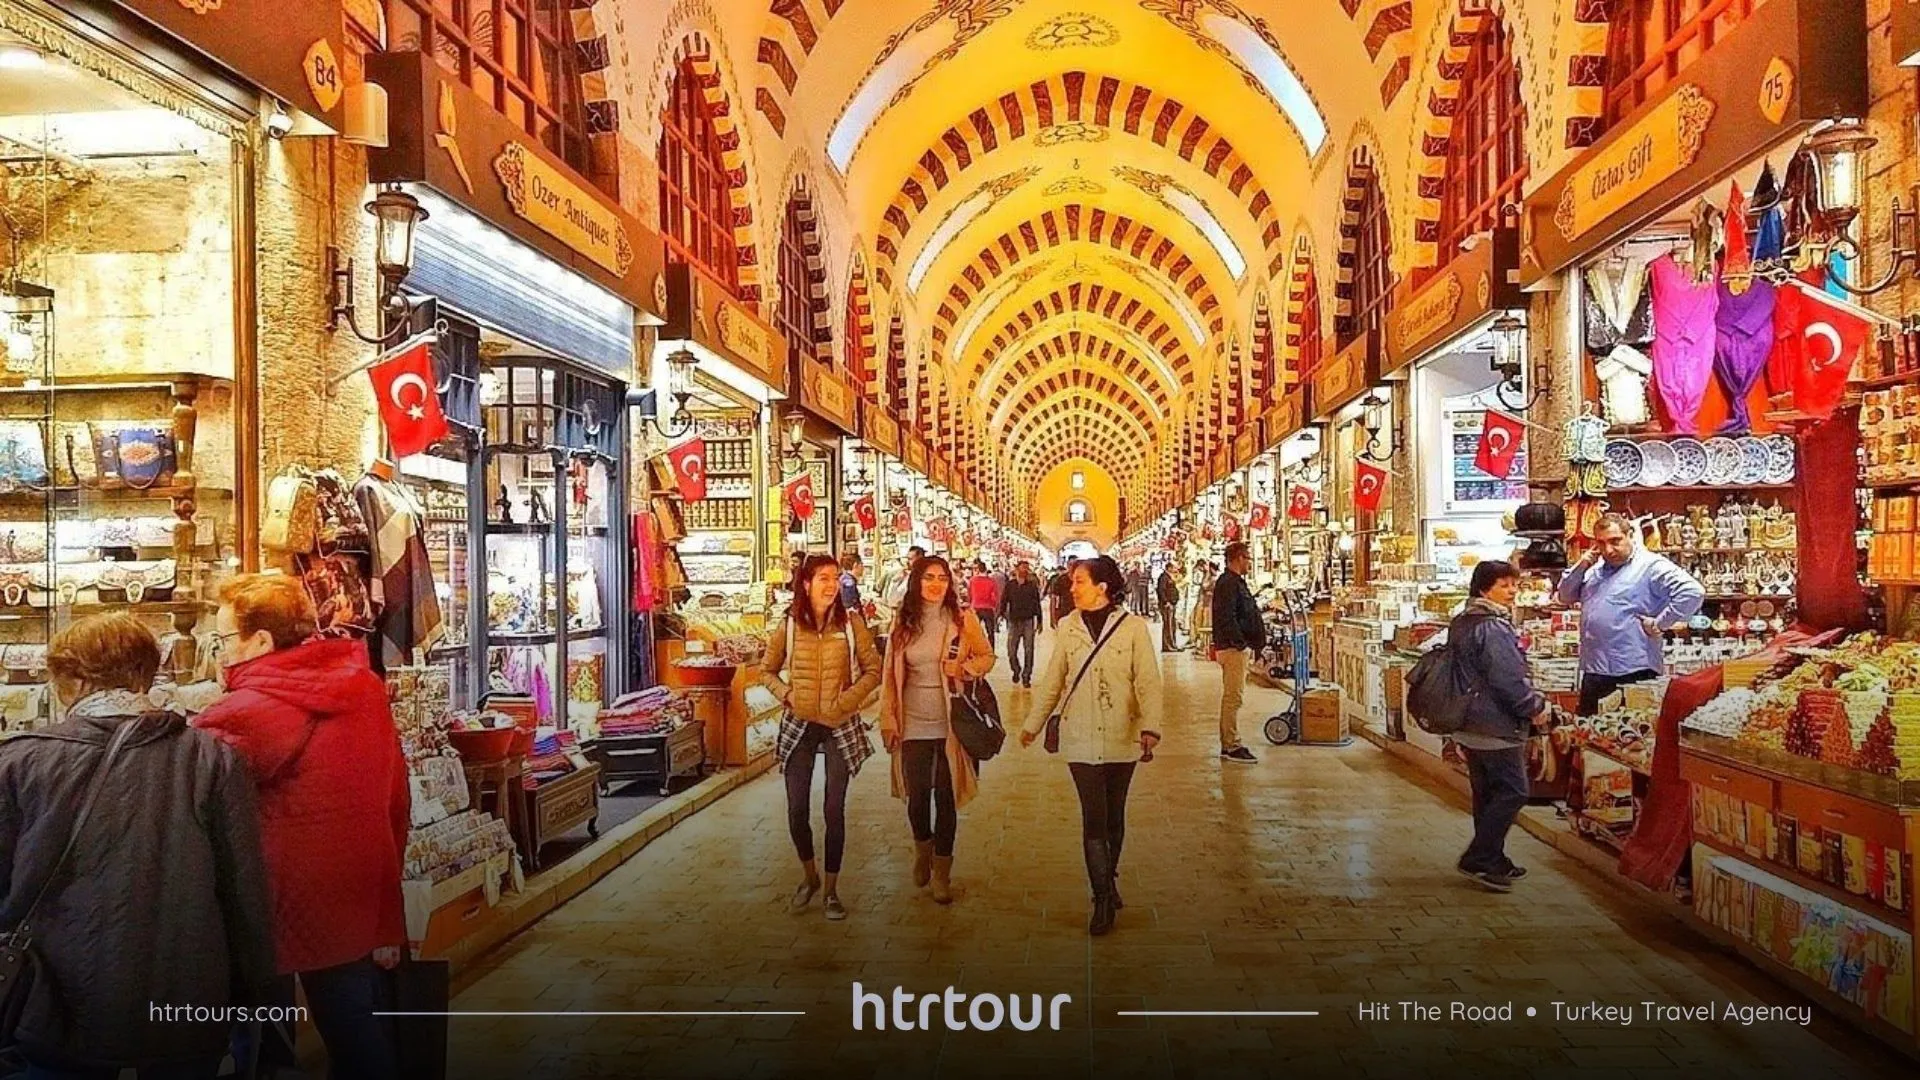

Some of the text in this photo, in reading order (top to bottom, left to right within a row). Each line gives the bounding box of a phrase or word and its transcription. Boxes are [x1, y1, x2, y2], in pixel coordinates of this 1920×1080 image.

[315, 55, 337, 91] 84
[1765, 72, 1784, 108] 75
[1627, 132, 1653, 182] Gift
[532, 174, 609, 247] Ozer Antiques
